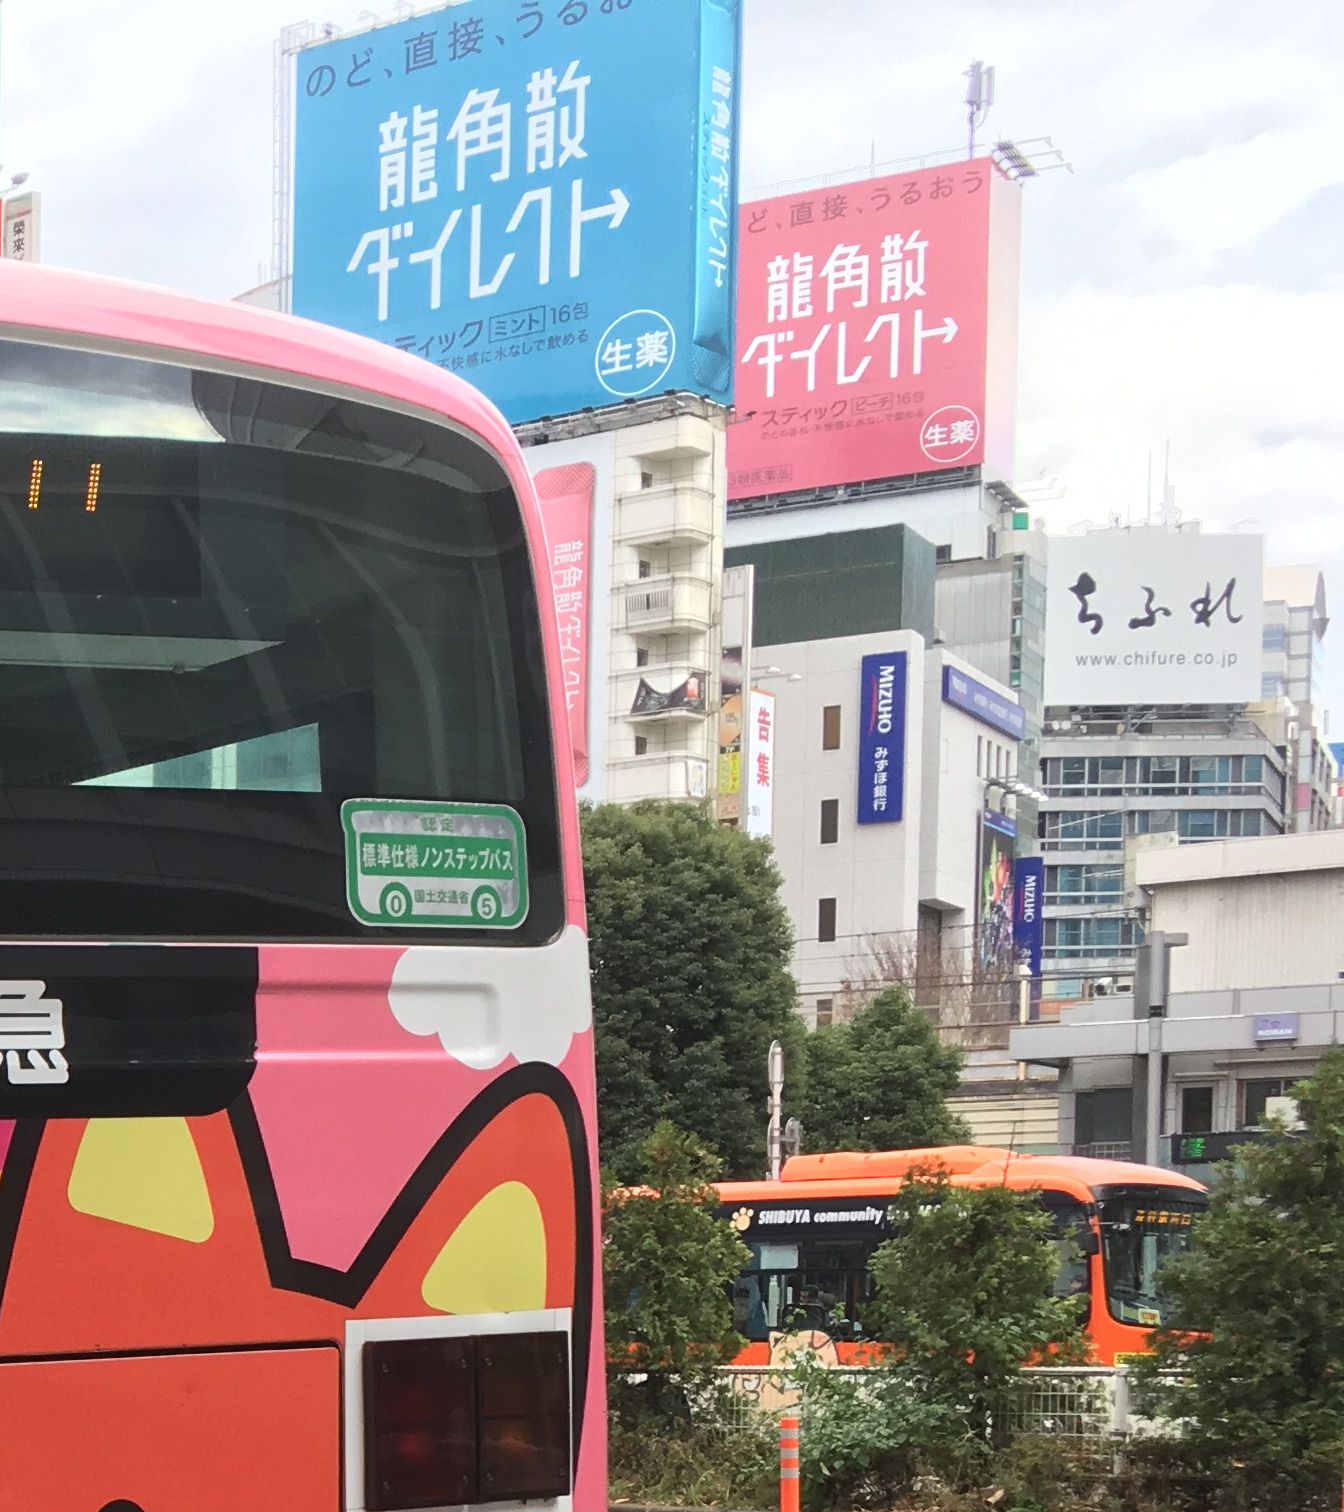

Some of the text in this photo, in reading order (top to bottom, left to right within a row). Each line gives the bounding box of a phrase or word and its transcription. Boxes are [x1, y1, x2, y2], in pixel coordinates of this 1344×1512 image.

[378, 59, 591, 212] 龍角散
[346, 178, 631, 321] ダイレクト
[767, 229, 929, 323] 龍角散
[493, 312, 541, 337] ミント
[549, 302, 589, 325] 16包
[601, 330, 670, 376] 生薬
[741, 308, 959, 398] ダイレクト
[762, 399, 848, 428] スティック
[924, 419, 976, 449] 生薬
[1068, 571, 1243, 636] ちふれ
[1075, 650, 1238, 668] www.chifure.co.jp
[877, 665, 895, 734] MIZUHO
[873, 746, 889, 812] みずほ銀行
[420, 816, 455, 833] 認定
[362, 842, 513, 872] 標準仕様ノンステップバス
[414, 888, 470, 905] 国土交通省
[1023, 875, 1037, 923] MIZUHO
[758, 1209, 810, 1225] SHIBUYA
[813, 1206, 883, 1225] community
